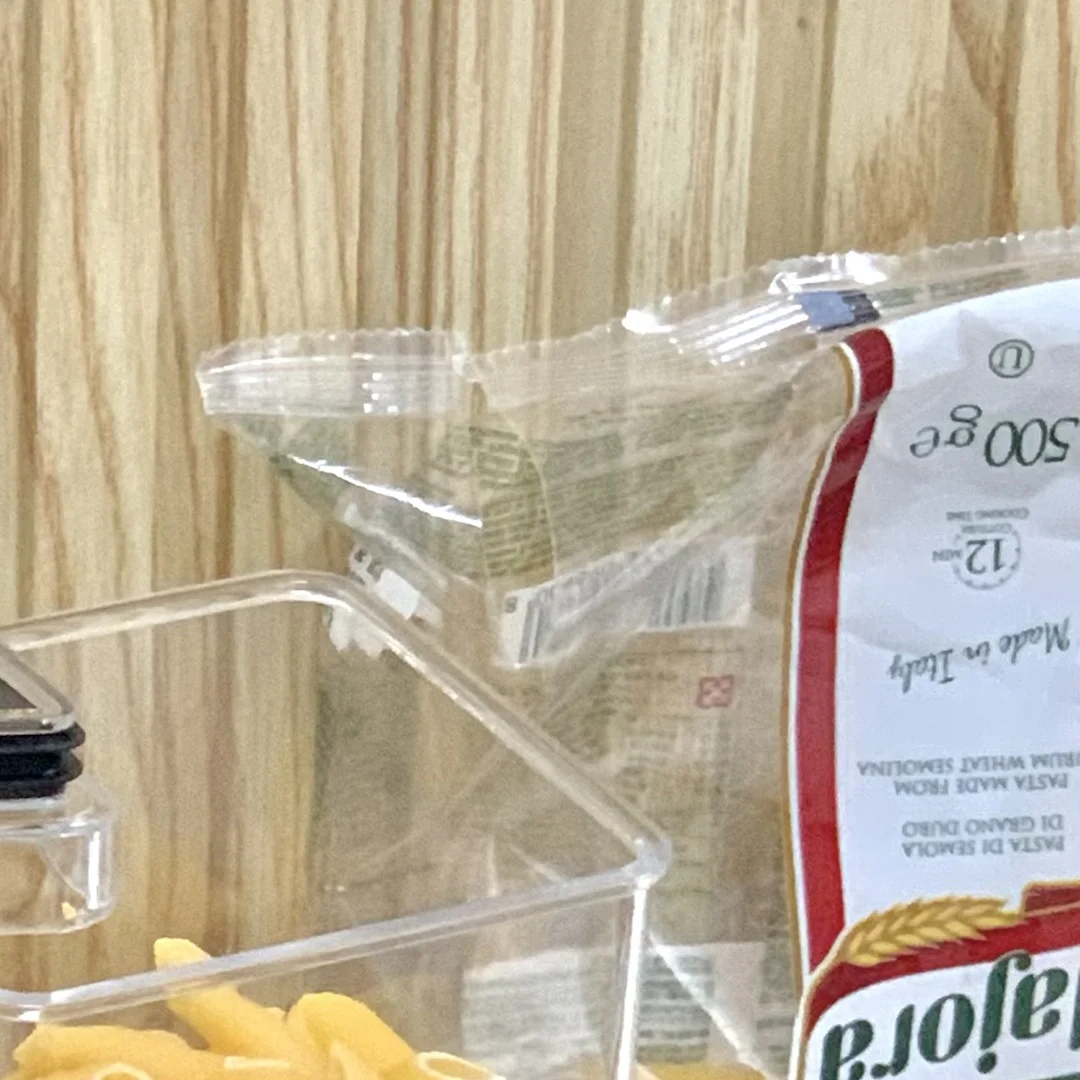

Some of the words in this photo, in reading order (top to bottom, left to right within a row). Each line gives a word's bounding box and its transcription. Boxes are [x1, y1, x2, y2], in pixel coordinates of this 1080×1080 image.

[966, 538, 1006, 574] 12
[1000, 617, 1071, 665] Made
[966, 641, 991, 665] in
[889, 650, 954, 693] Italy
[857, 757, 954, 776] SEMOLINA
[961, 756, 1025, 773] WHEAT
[893, 779, 949, 796] FROM
[956, 777, 1008, 794] MADE
[1013, 773, 1068, 791] PASTA
[901, 819, 960, 837] DURO
[965, 816, 1035, 834] GRANO
[1042, 814, 1064, 831] DI
[901, 840, 976, 857] SEMOLA
[982, 838, 1004, 855] DI
[1009, 835, 1065, 853] PASTA
